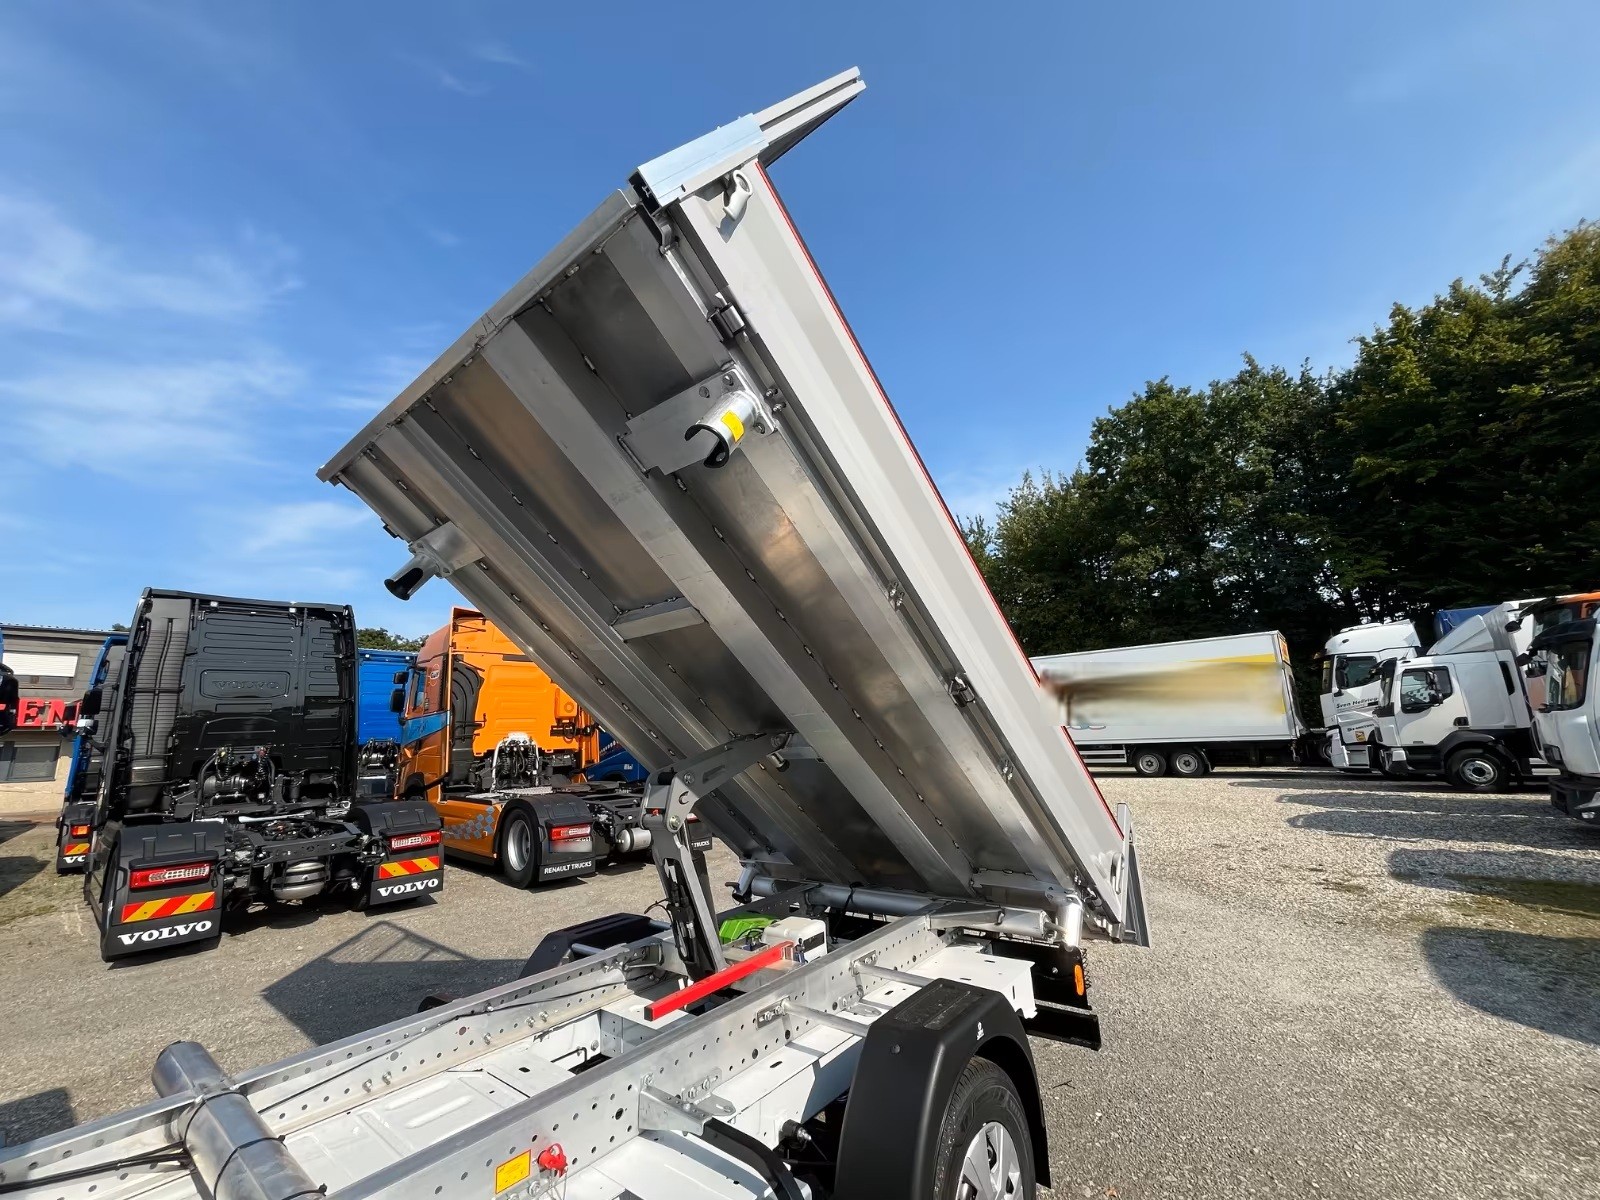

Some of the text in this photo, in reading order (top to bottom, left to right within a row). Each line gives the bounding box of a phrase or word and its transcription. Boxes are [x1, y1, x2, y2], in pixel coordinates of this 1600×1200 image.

[211, 680, 280, 690] VOLVO
[544, 860, 592, 875] RENAULT TRUCKS
[377, 878, 439, 897] VOLVO
[117, 920, 212, 945] VOLVO
